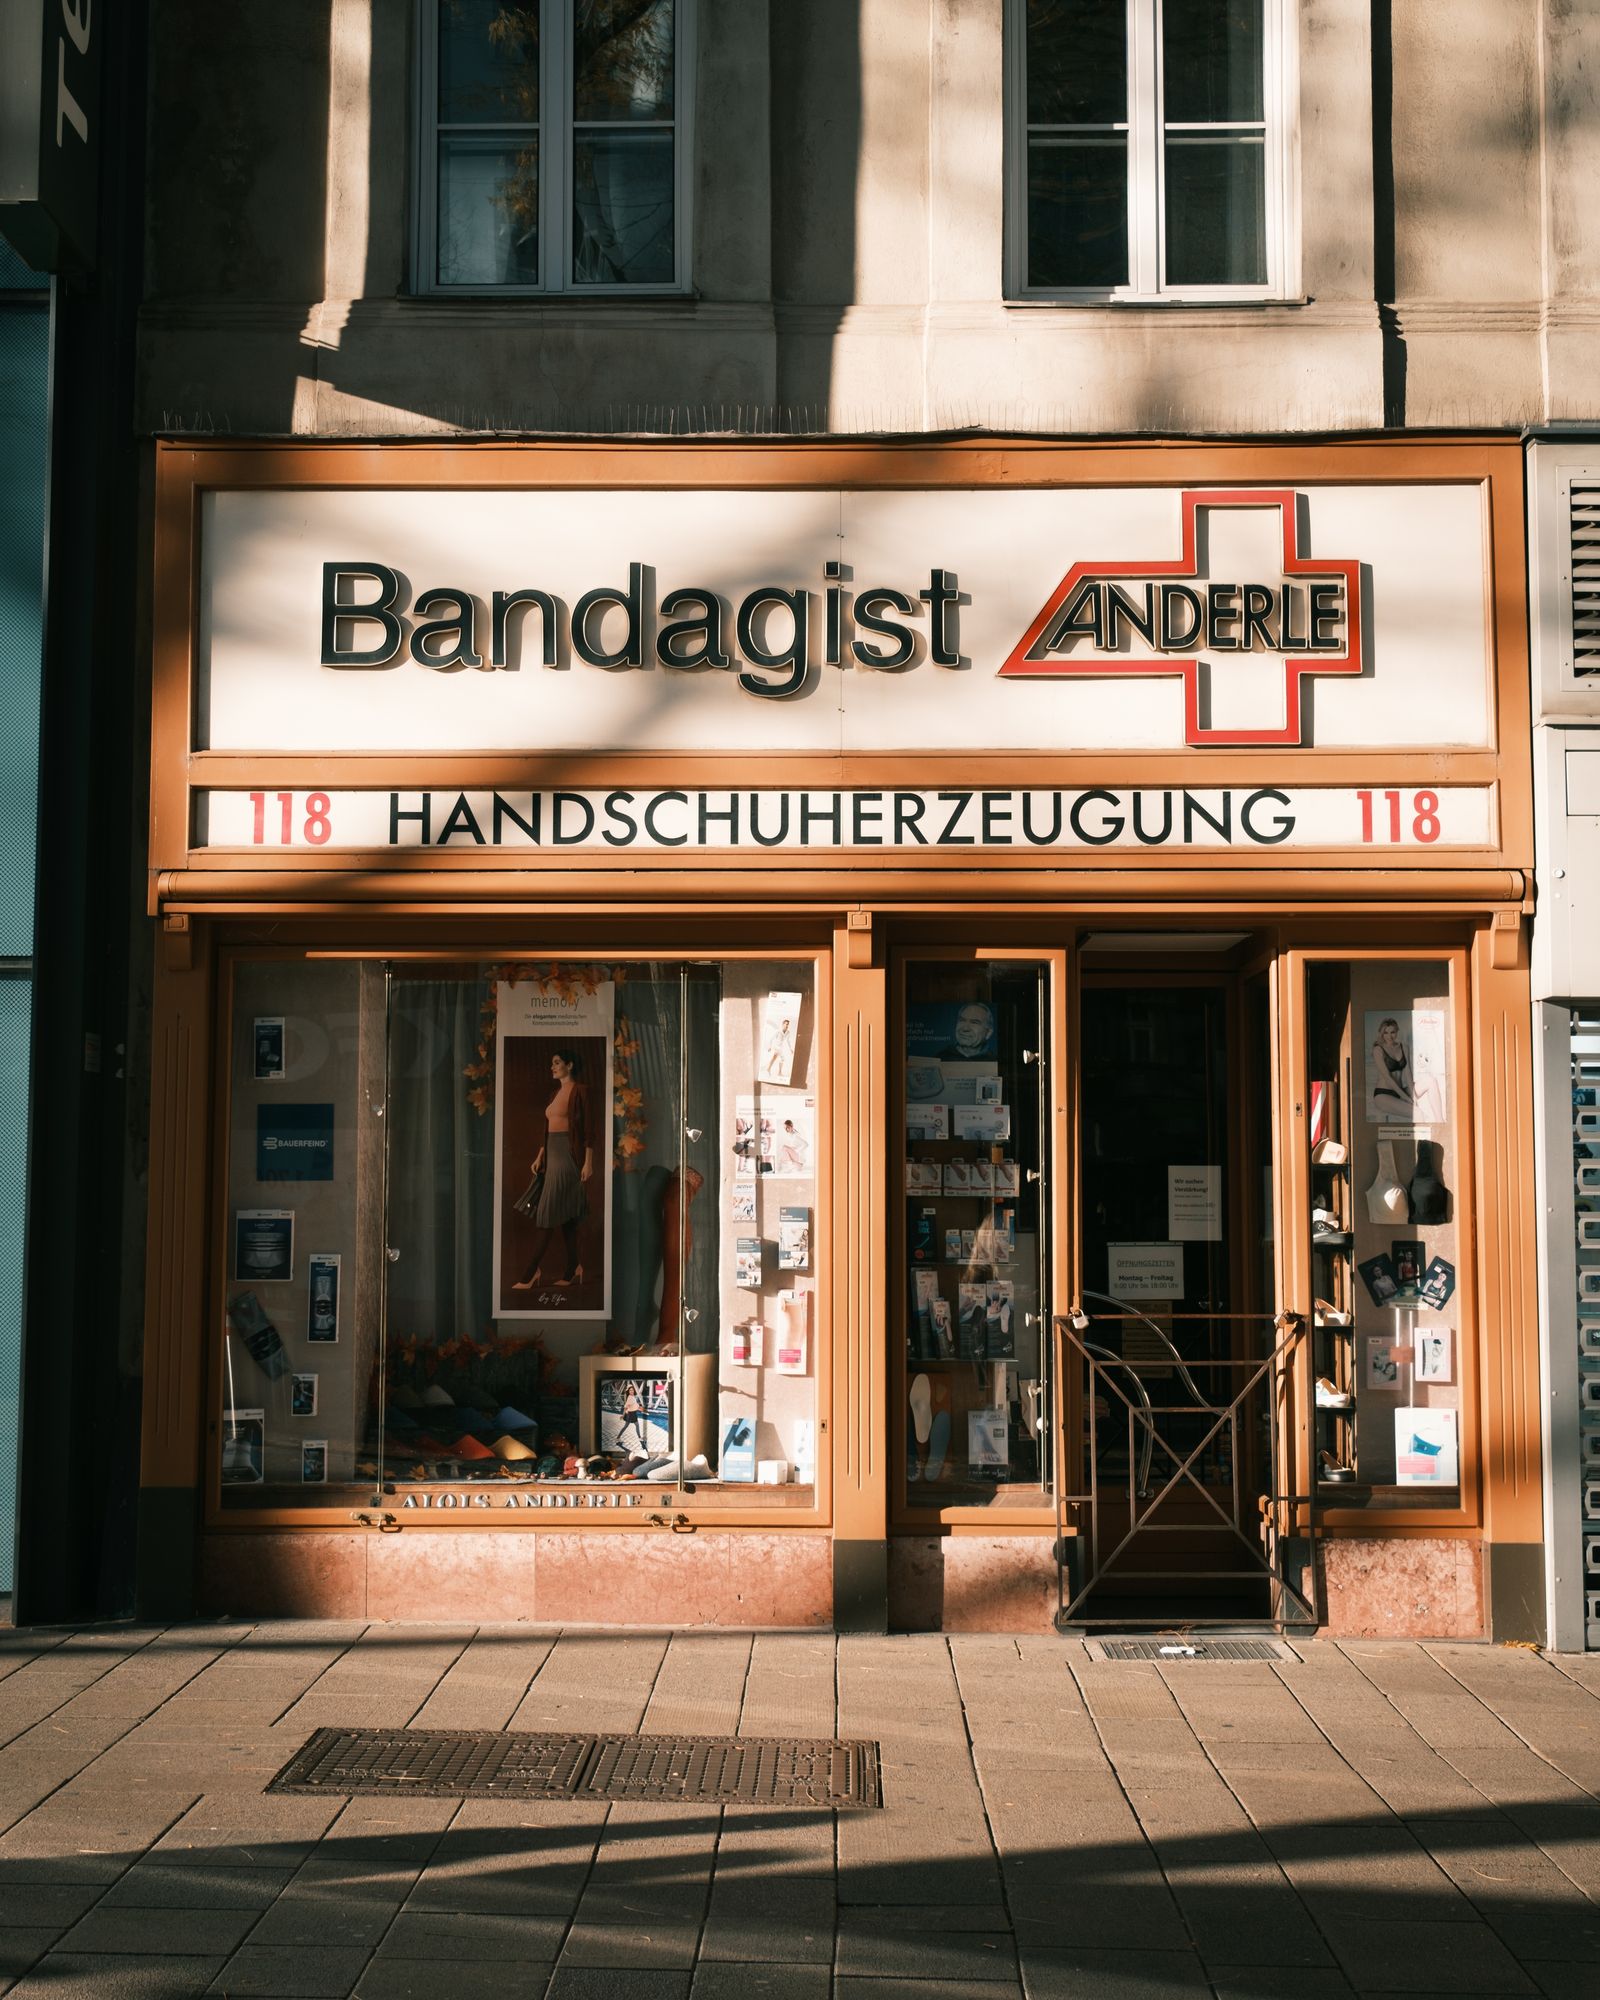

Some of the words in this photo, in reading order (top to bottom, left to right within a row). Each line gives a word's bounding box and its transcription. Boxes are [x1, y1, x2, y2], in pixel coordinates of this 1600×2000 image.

[320, 561, 960, 698] Bandagist
[1046, 582, 1342, 652] ANDERLE
[249, 792, 332, 845] 118
[389, 789, 1297, 847] HANDSCHUHERZEUGUNG
[1356, 790, 1441, 844] 118
[278, 1139, 326, 1148] BAUERFEIND
[1116, 1259, 1176, 1268] ÖFFNUNGSZEITEN
[1150, 1274, 1174, 1282] Freitag
